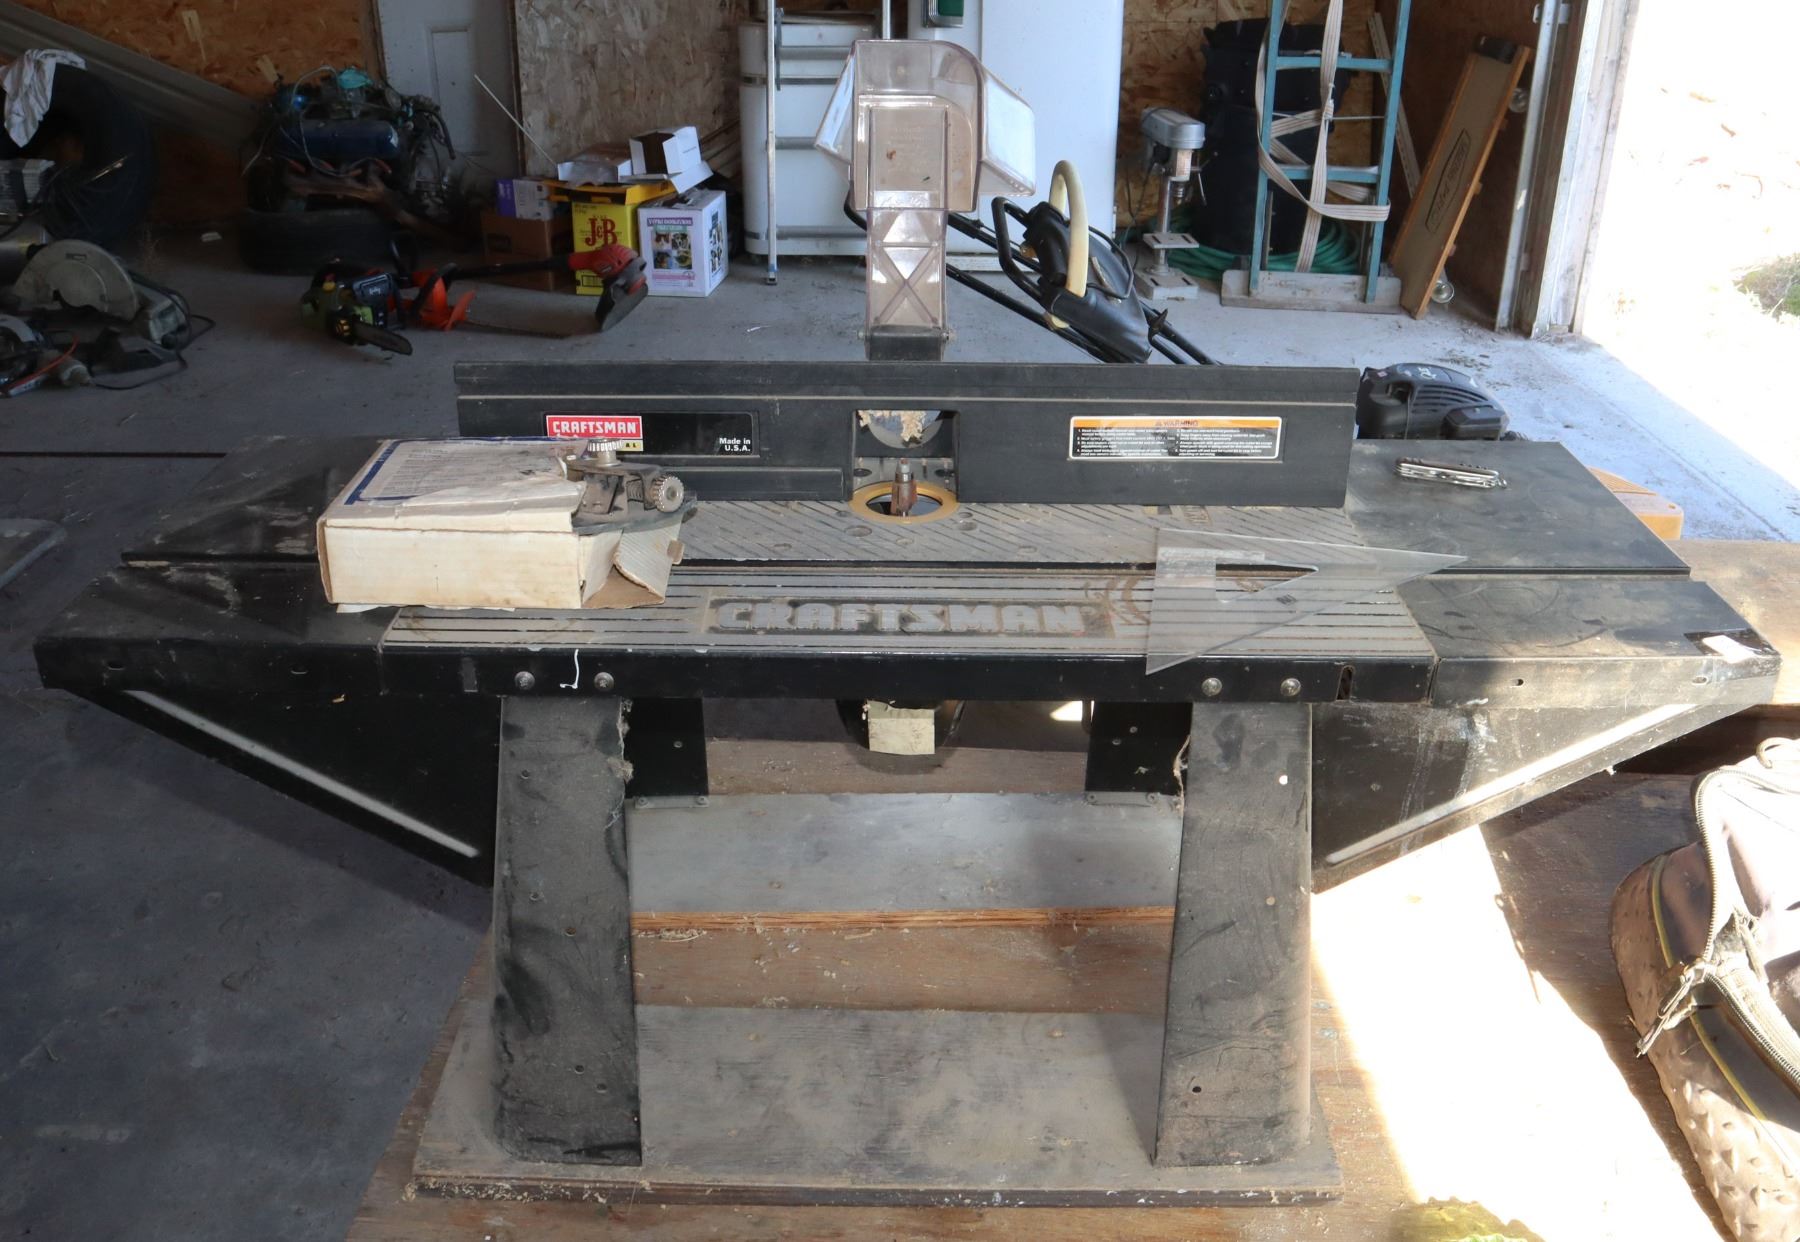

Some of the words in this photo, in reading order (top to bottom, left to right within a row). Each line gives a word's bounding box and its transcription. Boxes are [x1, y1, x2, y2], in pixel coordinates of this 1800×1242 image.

[585, 217, 617, 246] J&B
[553, 420, 637, 434] CRAFTSMAN
[719, 437, 741, 445] Made
[743, 437, 751, 445] in
[724, 444, 751, 452] U.S.A.
[719, 602, 1085, 633] CRAFTSMAN
